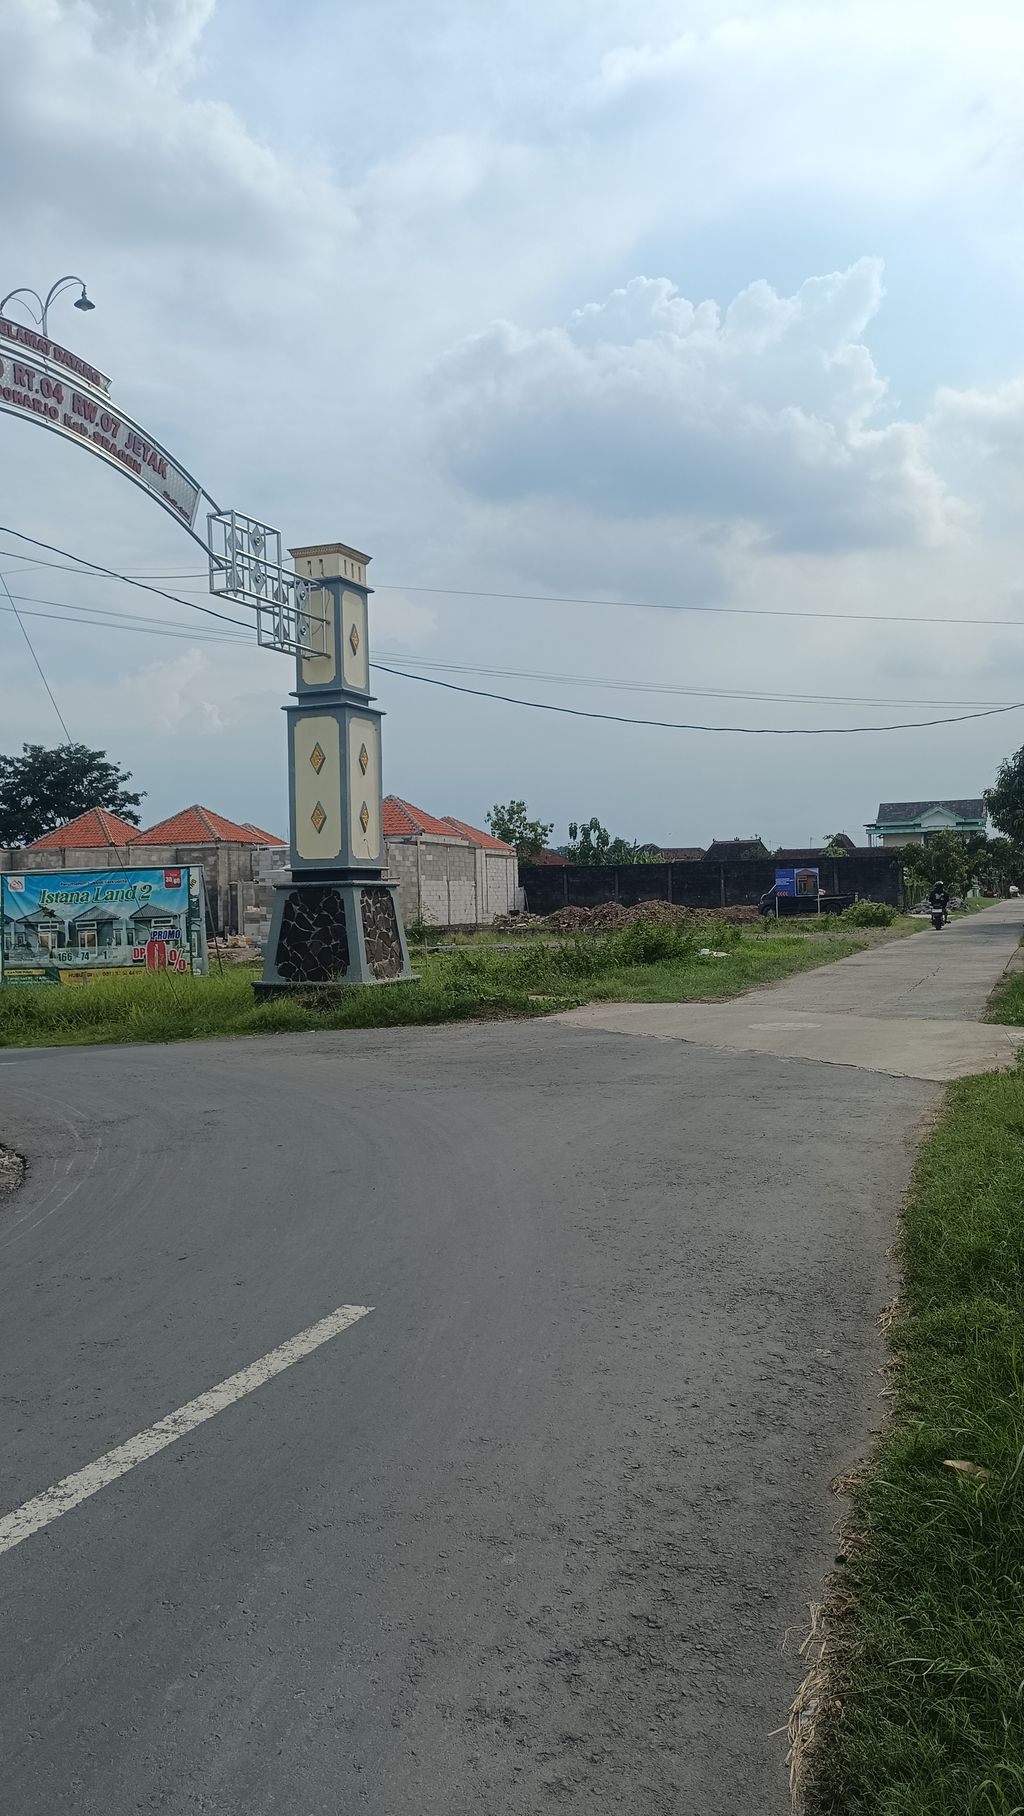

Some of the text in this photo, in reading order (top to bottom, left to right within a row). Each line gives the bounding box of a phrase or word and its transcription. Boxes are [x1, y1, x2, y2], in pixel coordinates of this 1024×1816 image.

[0, 319, 101, 386] ELAMAT DATANG
[13, 362, 64, 405] RT.04
[72, 392, 121, 438] RW.07
[125, 432, 170, 480] JETAK
[39, 884, 153, 905] Istana Land 2
[151, 929, 182, 941] PROMO
[81, 951, 90, 961] 74
